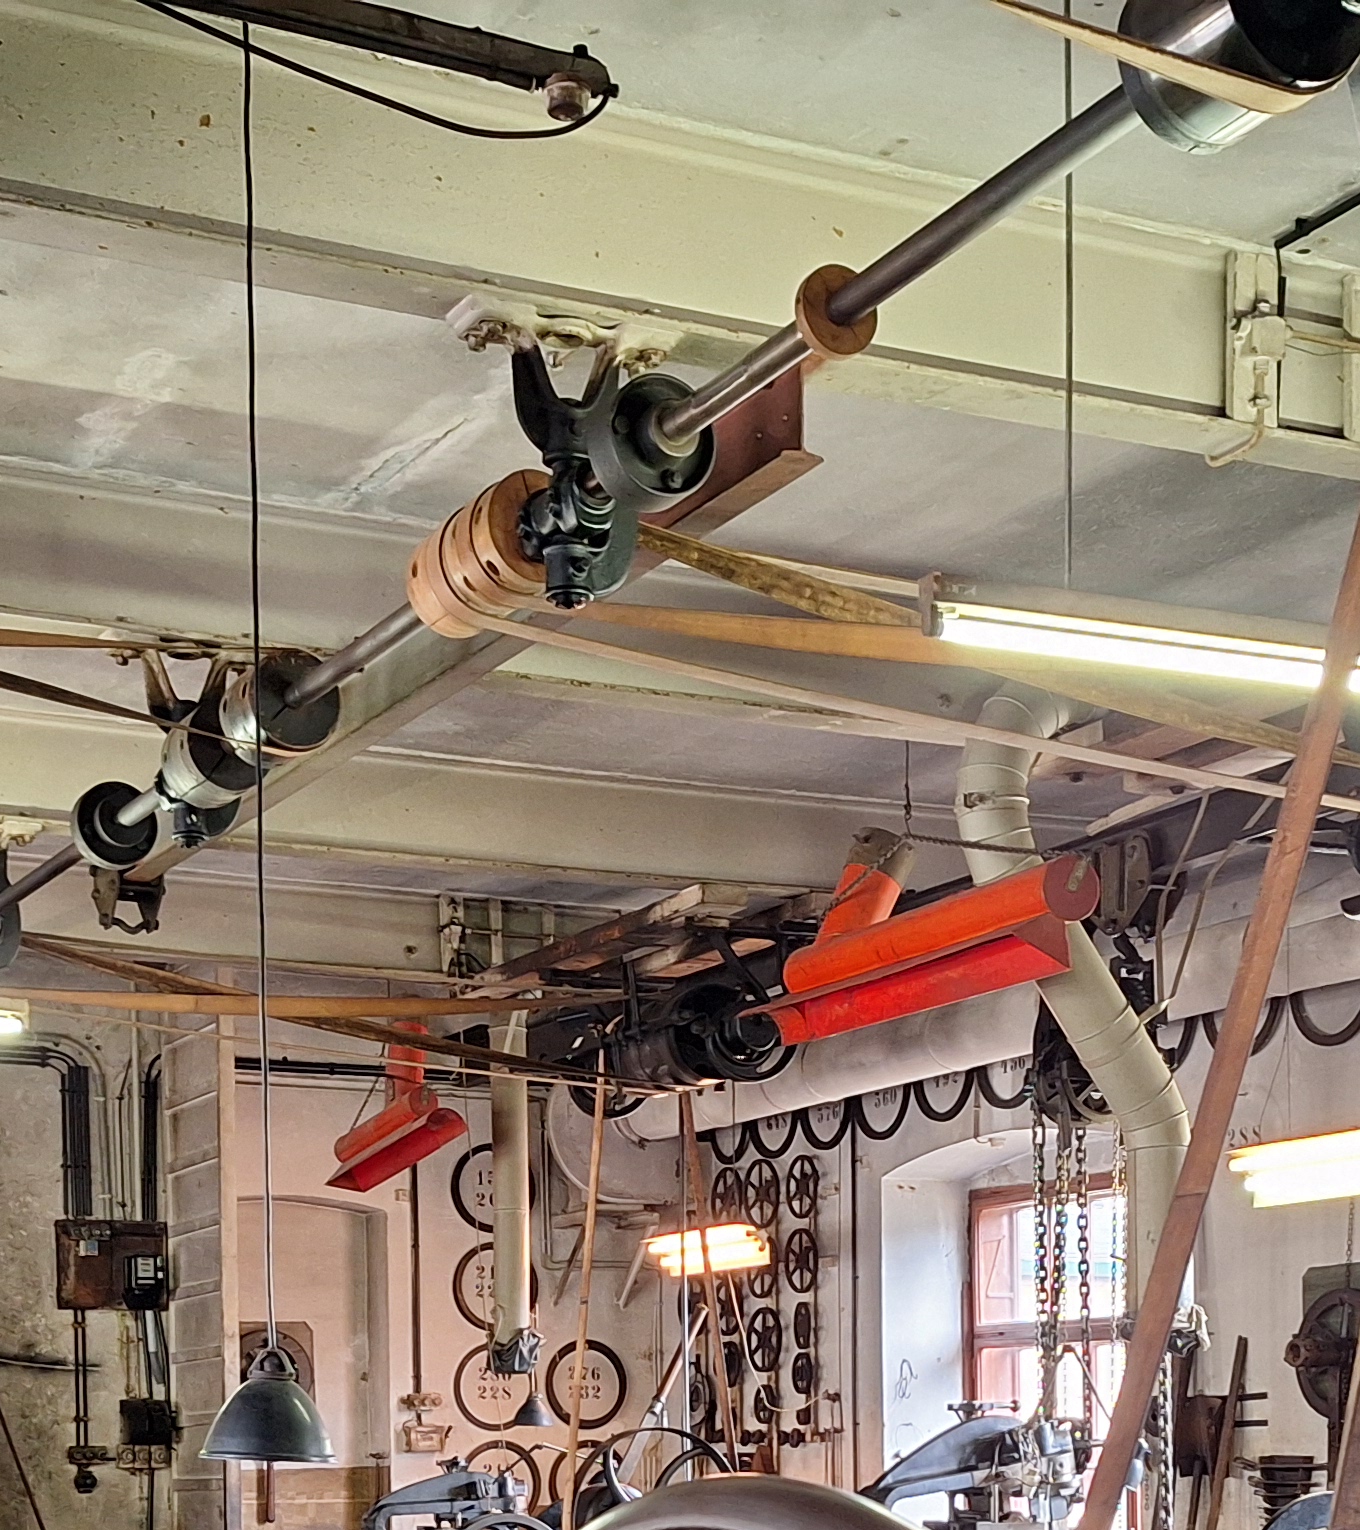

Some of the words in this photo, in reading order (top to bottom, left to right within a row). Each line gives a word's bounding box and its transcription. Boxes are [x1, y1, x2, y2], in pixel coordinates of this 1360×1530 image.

[817, 1102, 839, 1124] 576
[1226, 1125, 1261, 1148] 288
[477, 1385, 512, 1400] 228
